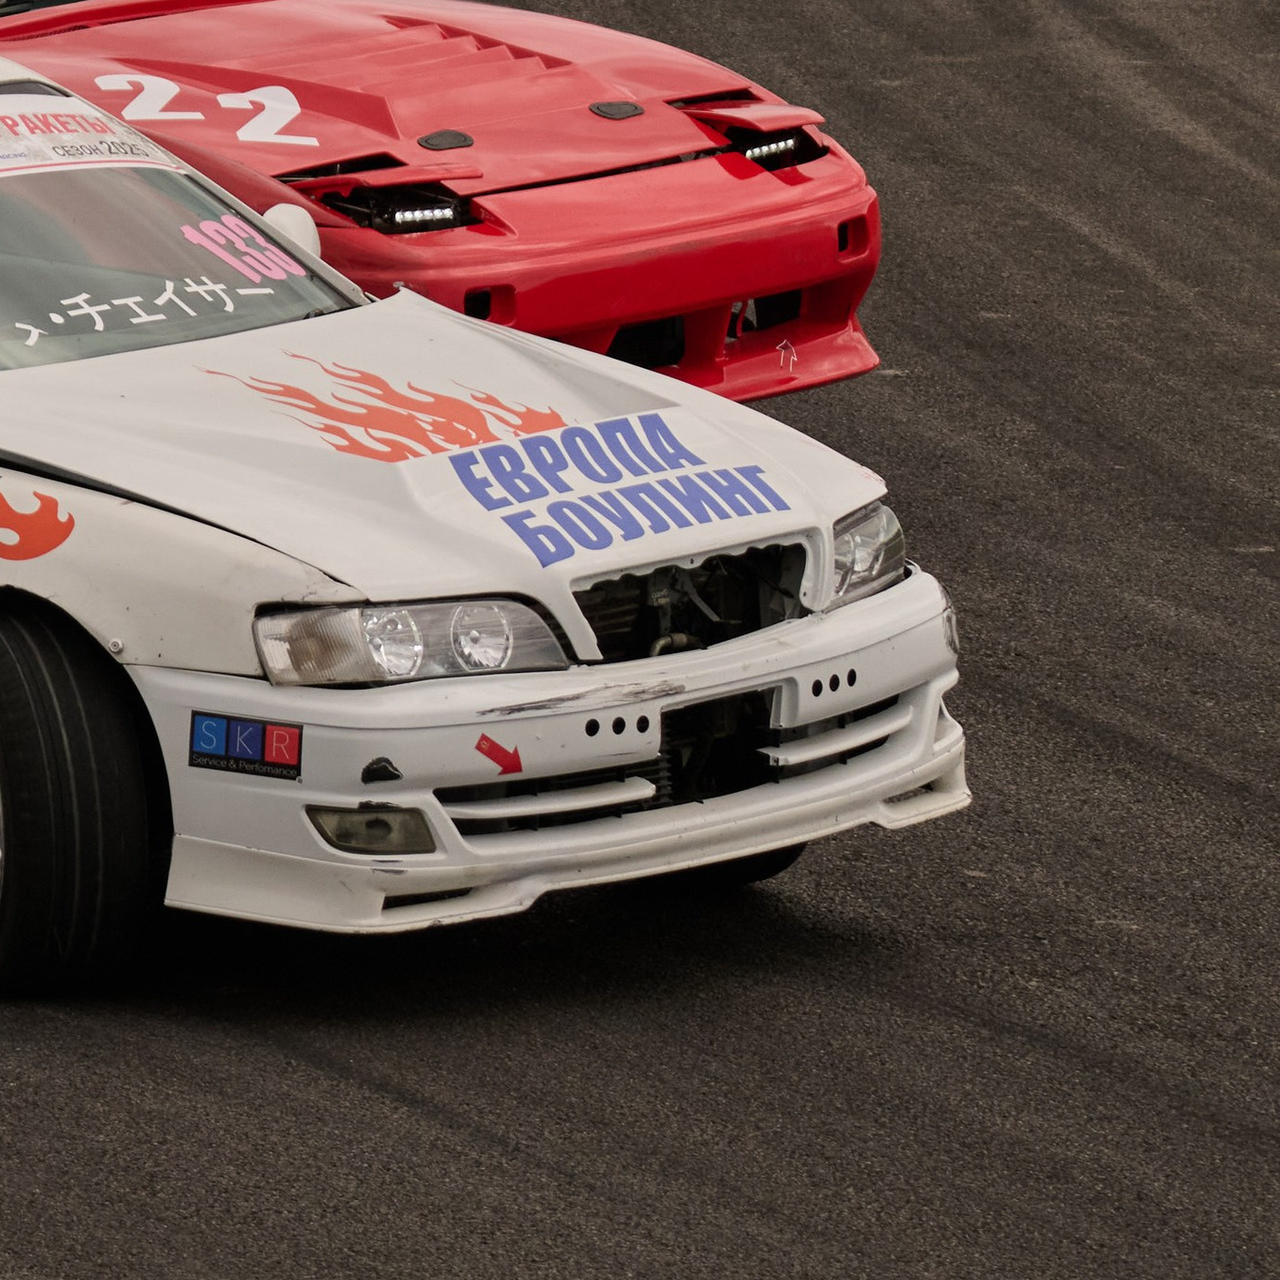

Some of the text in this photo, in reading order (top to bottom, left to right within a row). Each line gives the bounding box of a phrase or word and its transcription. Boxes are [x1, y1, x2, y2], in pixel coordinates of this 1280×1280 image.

[52, 140, 150, 158] СЕЗОН 2025
[448, 412, 707, 512] ЕВРОПА
[500, 464, 792, 569] БОУЛИНГ
[200, 720, 291, 760] SKR
[192, 753, 228, 769] Service
[228, 759, 238, 769] &
